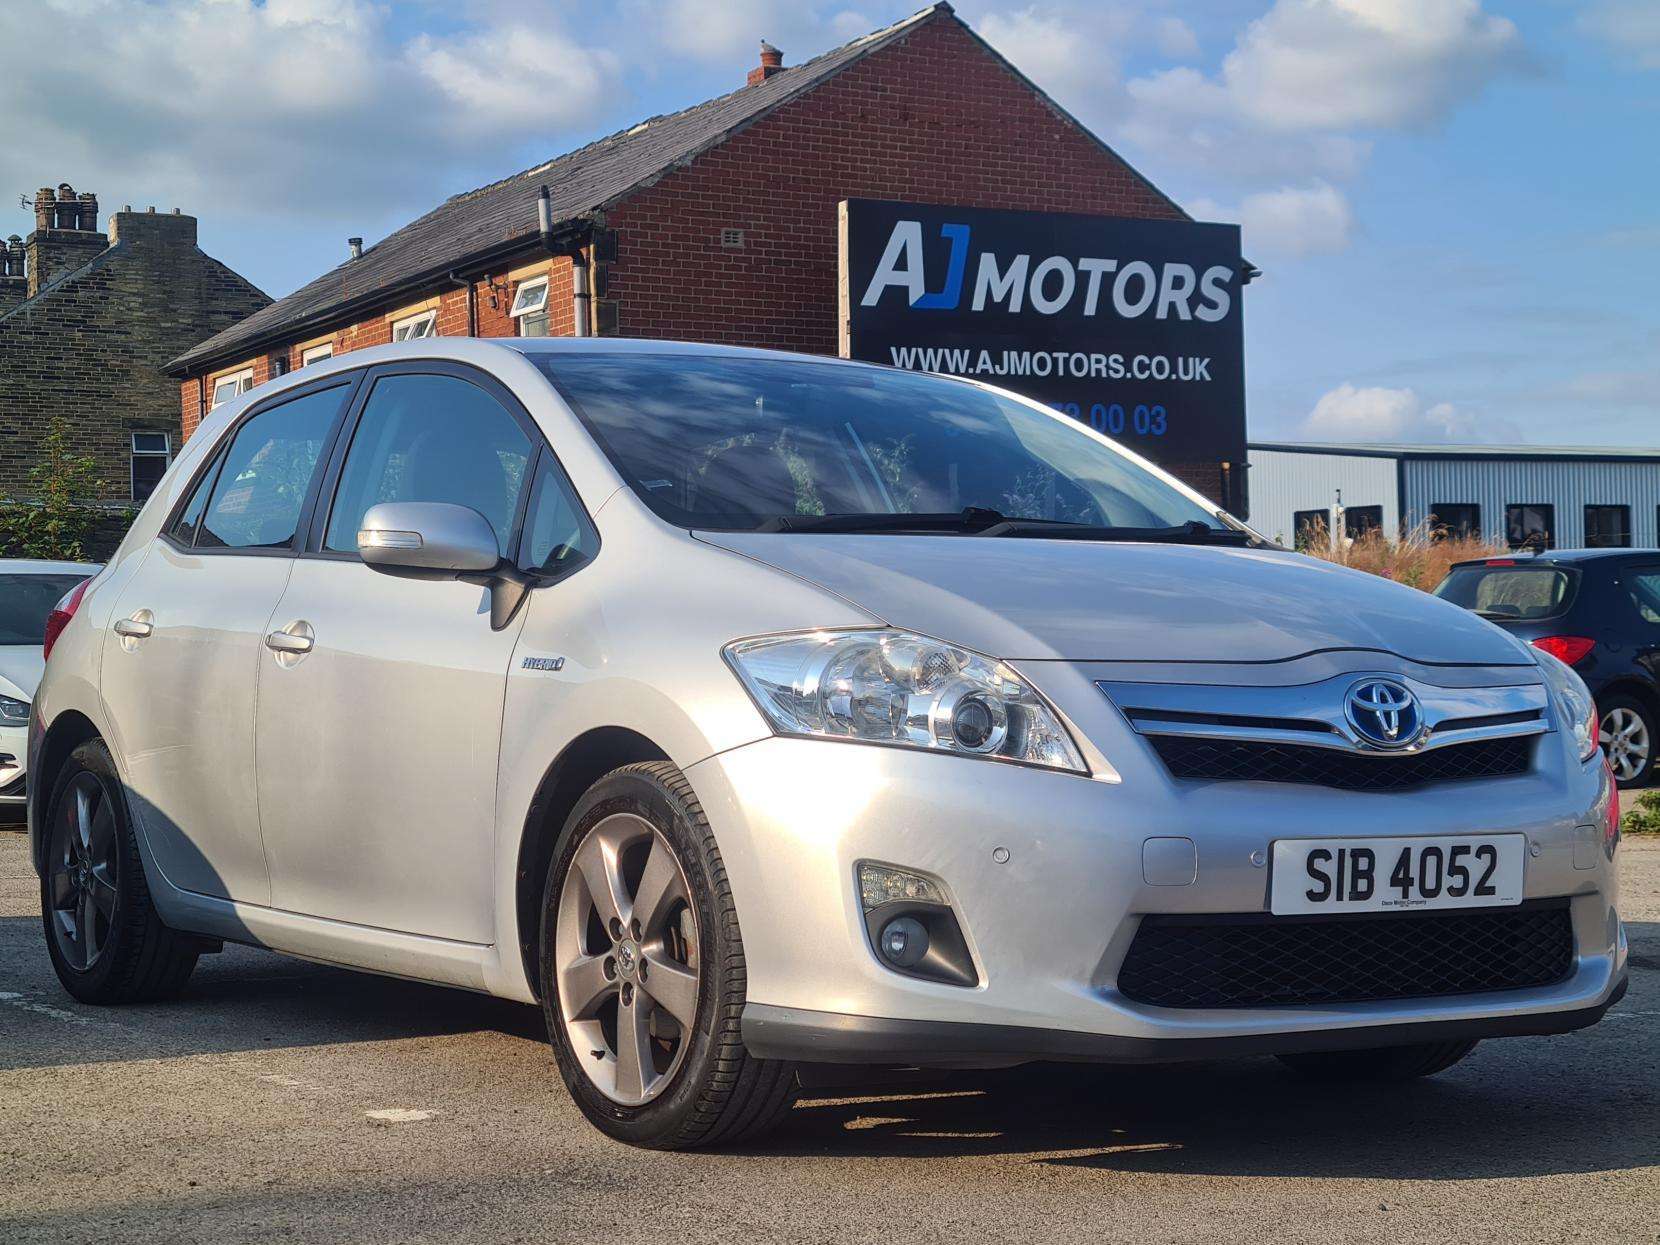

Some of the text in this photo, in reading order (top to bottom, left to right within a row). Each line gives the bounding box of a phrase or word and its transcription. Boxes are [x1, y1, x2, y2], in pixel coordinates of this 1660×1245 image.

[861, 221, 1233, 322] AJ MOTORS
[890, 346, 1212, 381] WWW.AJMOTORS.CO.UK
[1090, 403, 1125, 434] 00
[1134, 404, 1168, 436] 03
[1305, 844, 1497, 902] SIB 4052
